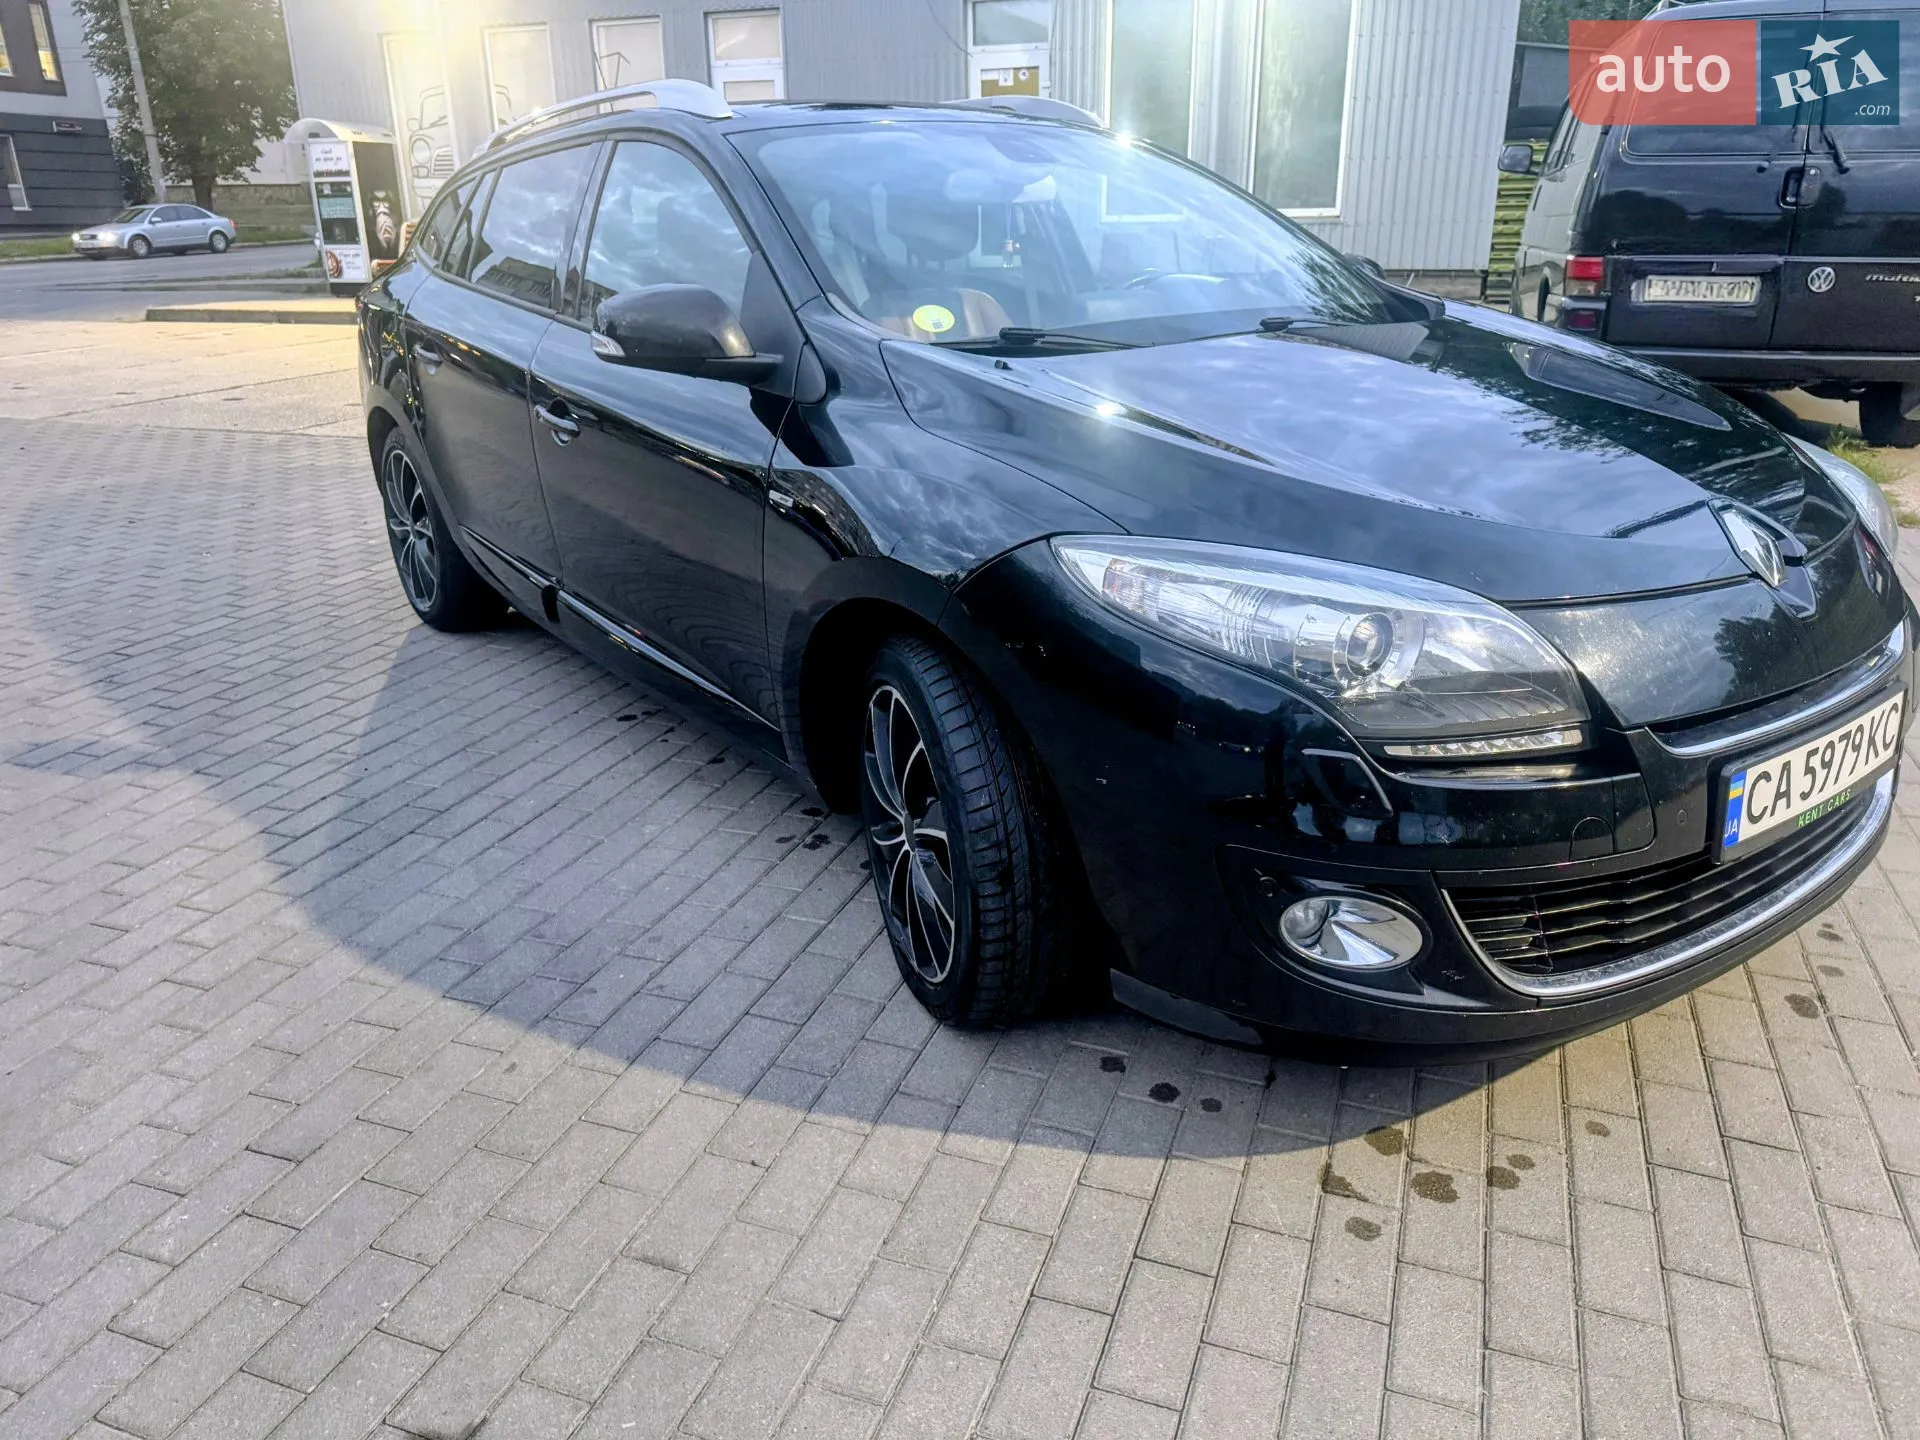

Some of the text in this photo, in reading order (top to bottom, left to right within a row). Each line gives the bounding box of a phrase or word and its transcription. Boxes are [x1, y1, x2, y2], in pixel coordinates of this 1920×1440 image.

[1747, 760, 1791, 824] CA
[1798, 788, 1851, 828] KENT CARS
